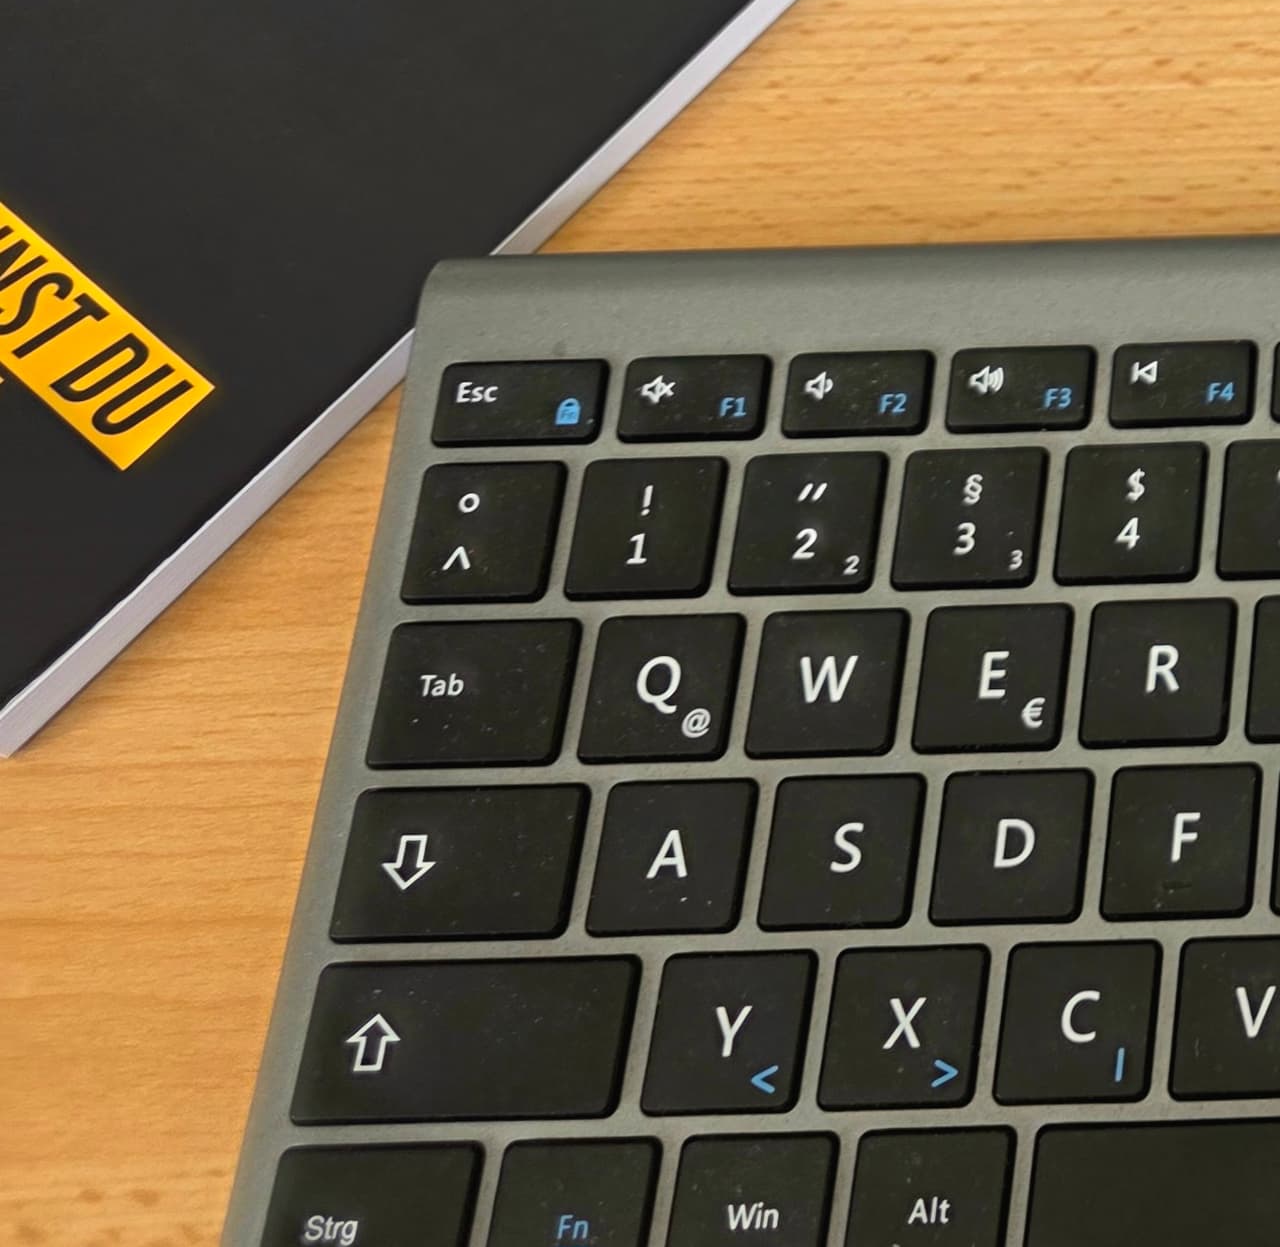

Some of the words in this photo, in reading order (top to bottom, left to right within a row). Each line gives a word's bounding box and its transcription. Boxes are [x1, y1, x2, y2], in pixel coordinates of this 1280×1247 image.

[50, 332, 194, 436] DU
[456, 381, 499, 403] Esc
[1044, 387, 1072, 408] F3
[1208, 383, 1234, 400] F4
[719, 397, 746, 418] F1
[879, 393, 907, 414] F2
[641, 485, 654, 516] !
[963, 473, 983, 505] §
[1127, 468, 1146, 501] $
[626, 533, 647, 565] 1
[792, 528, 818, 559] 2
[954, 522, 976, 555] 3
[1116, 517, 1141, 549] 4
[843, 555, 860, 575] 2
[1009, 549, 1023, 570] 3
[636, 655, 681, 714] Q
[800, 655, 859, 703] W
[978, 650, 1010, 699] E
[1146, 644, 1180, 693] R
[420, 673, 464, 697] Tab
[681, 708, 711, 738] @
[1021, 697, 1046, 728] €
[830, 822, 864, 873] S
[993, 818, 1035, 868] D
[1171, 812, 1201, 862] F
[646, 829, 688, 879] A
[882, 997, 927, 1050] X
[1061, 990, 1100, 1043] C
[1236, 985, 1276, 1038] V
[716, 1005, 753, 1058] Y
[557, 1215, 589, 1237] Fn
[727, 1201, 779, 1231] Win
[907, 1196, 951, 1225] Alt
[305, 1215, 359, 1247] Strg
